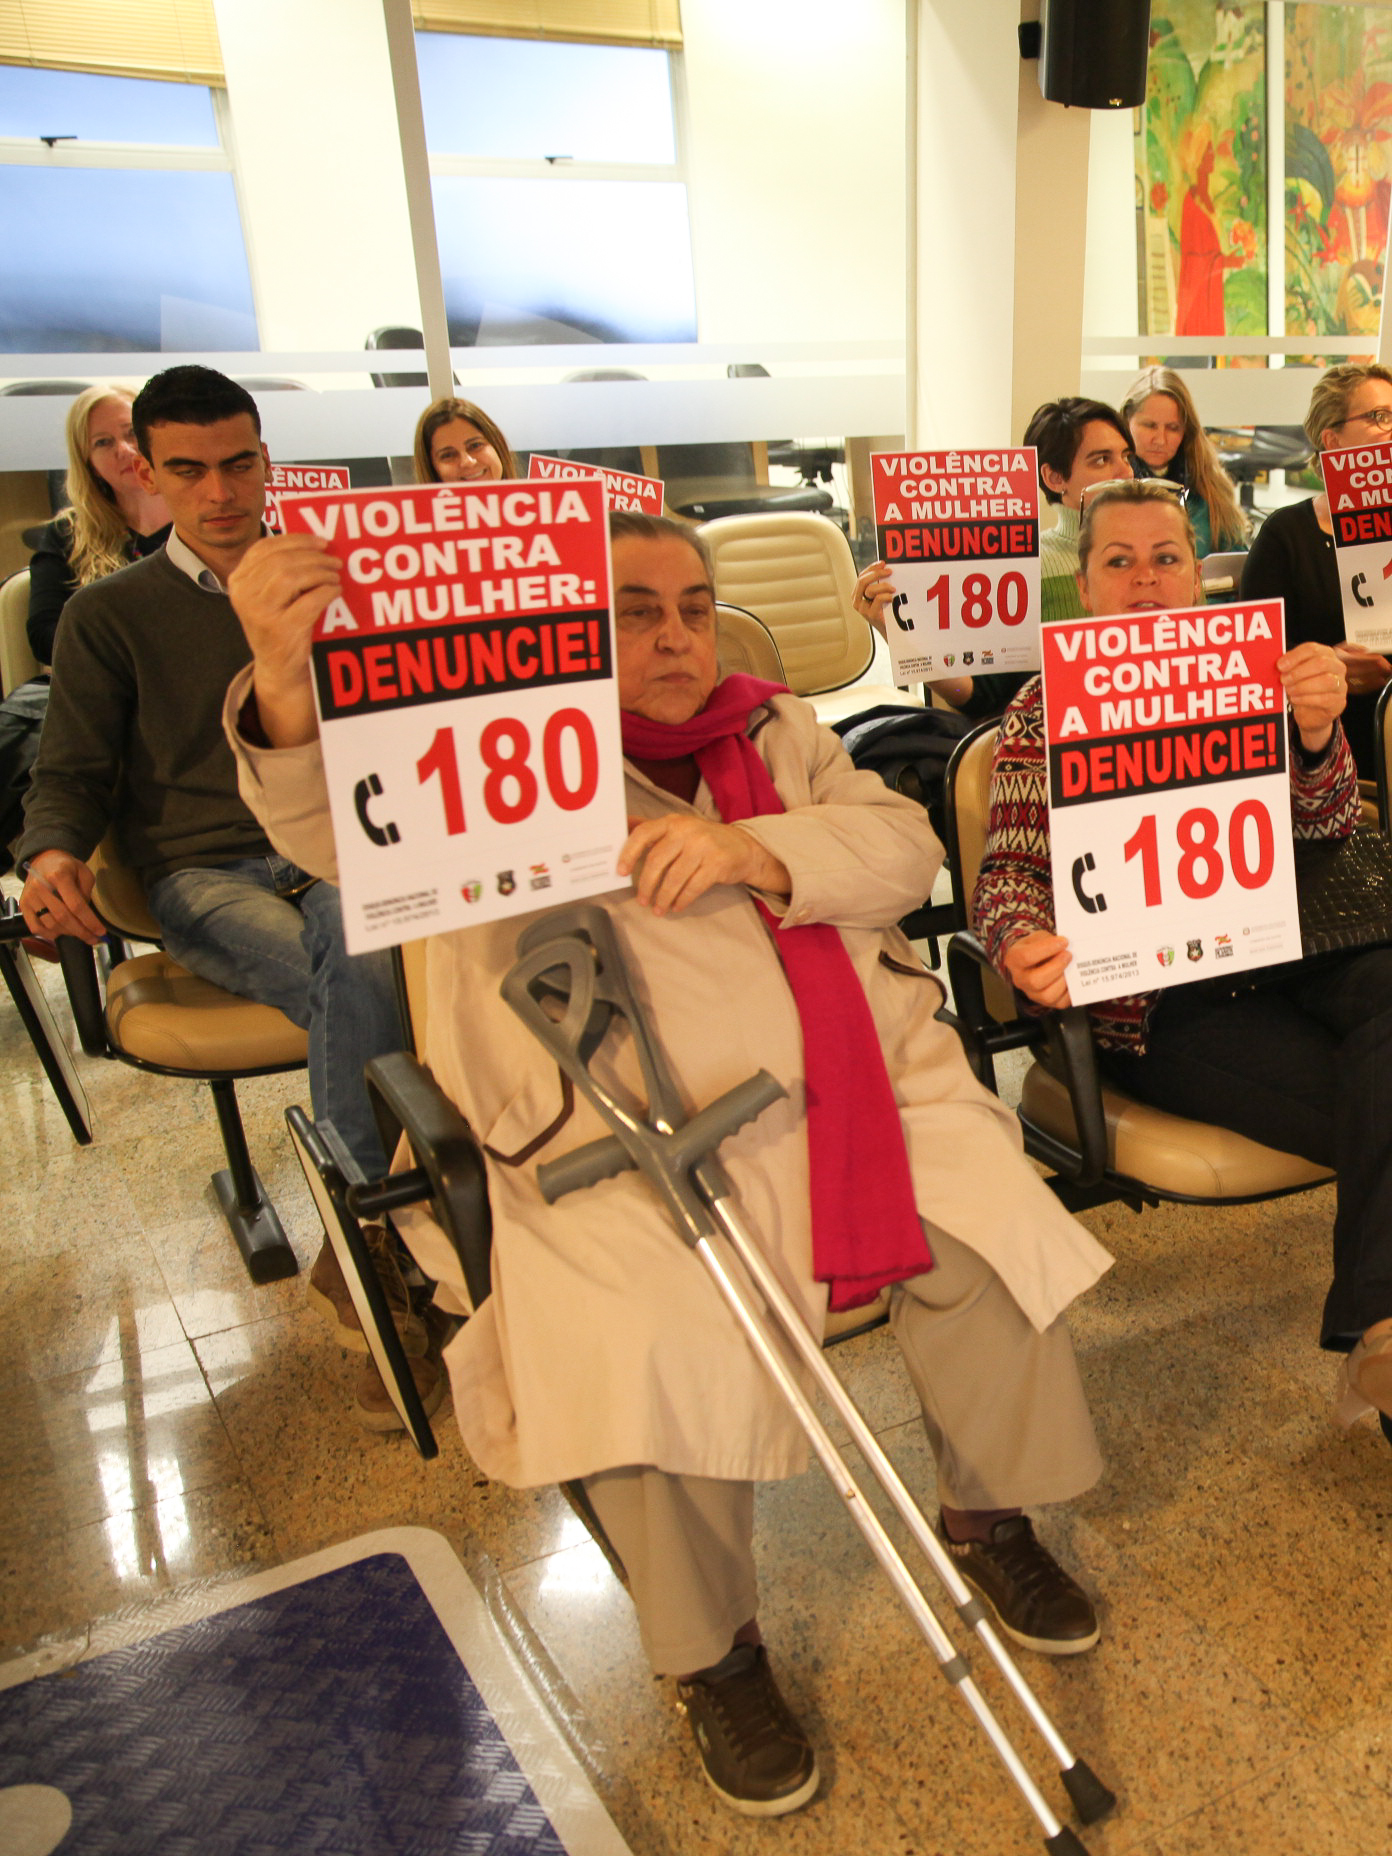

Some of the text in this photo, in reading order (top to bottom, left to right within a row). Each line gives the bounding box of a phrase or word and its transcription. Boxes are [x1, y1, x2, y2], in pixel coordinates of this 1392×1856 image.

[264, 467, 343, 489] ÊNCIA
[880, 452, 1028, 476] VIOLÊNCIA
[900, 477, 1013, 498] CONTRA
[299, 489, 590, 541] VIOLÊNCIA
[884, 499, 1032, 521] A MULHER:
[1337, 494, 1355, 511] A
[348, 534, 560, 583] CONTRA
[885, 525, 1033, 558] DENUNCIE!
[322, 574, 596, 633] A MULHER:
[927, 571, 1028, 629] 180
[1053, 612, 1272, 662] VIOLÊNCIA
[328, 620, 601, 707] DENUNCIE!
[1084, 650, 1250, 696] CONTRA
[1059, 683, 1274, 737] A MULHER:
[417, 707, 599, 836] 180
[1061, 723, 1277, 798] DENUNCIE!
[1124, 799, 1275, 907] 180
